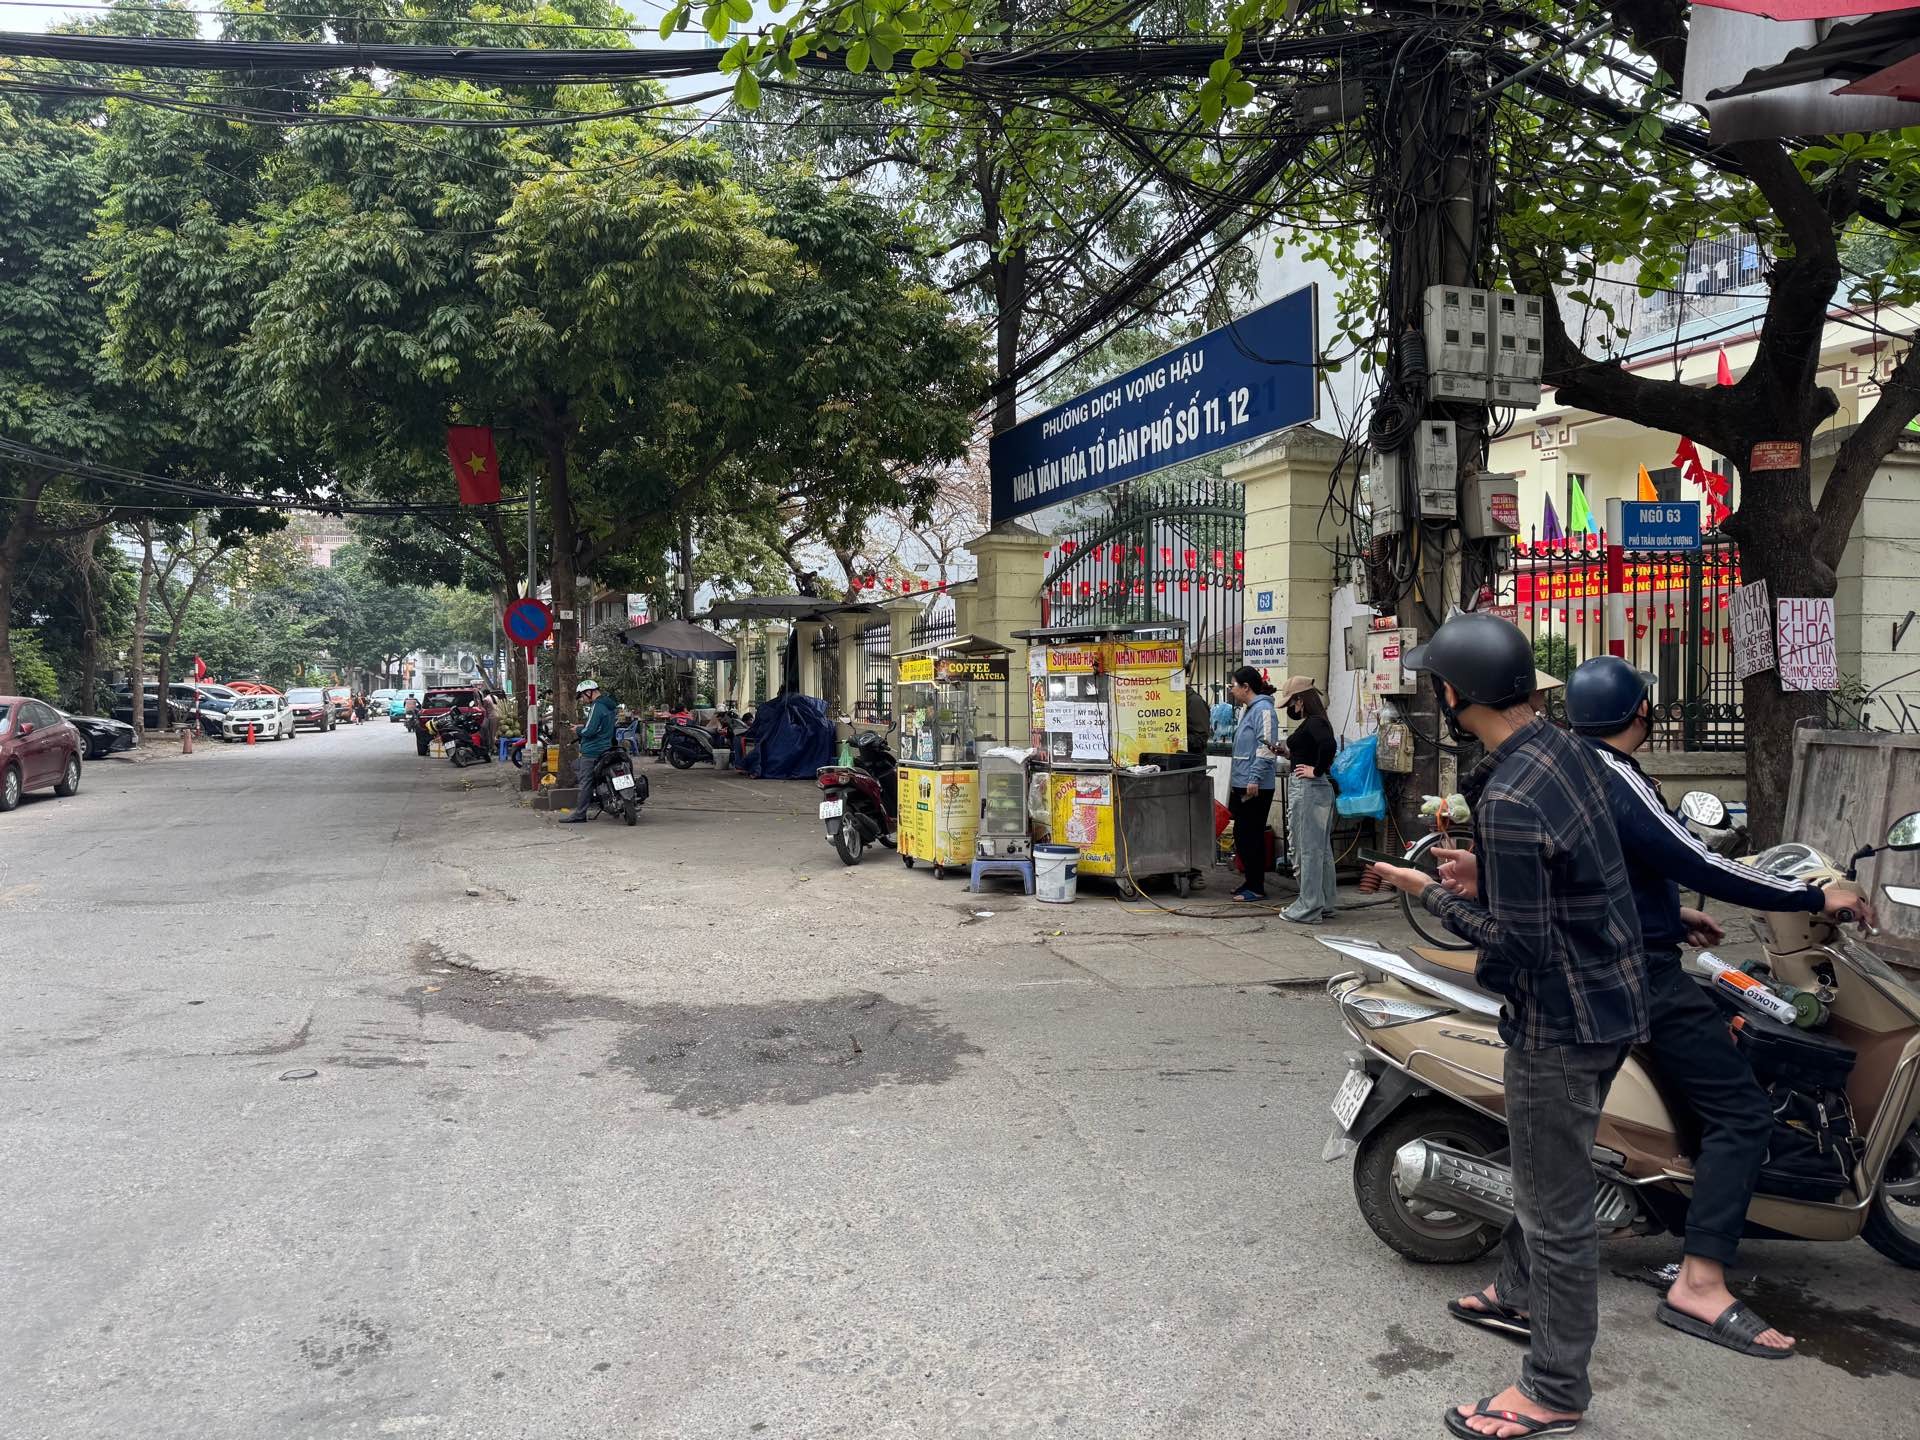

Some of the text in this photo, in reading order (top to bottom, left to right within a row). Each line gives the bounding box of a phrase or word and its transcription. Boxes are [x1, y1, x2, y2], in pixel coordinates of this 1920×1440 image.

[1043, 350, 1204, 439] PHƯỜNG DỊCH VỌNG HẬU
[1013, 466, 1035, 503] NHÀ
[1037, 458, 1060, 494] VĂN
[1062, 446, 1087, 483] HÓA
[1089, 428, 1104, 475] TỔ
[1108, 427, 1139, 470] DÂN
[1141, 402, 1173, 457] PHỐ
[1176, 390, 1200, 445] SỐ
[1203, 397, 1225, 435] 11,
[1228, 387, 1250, 426] 12
[1640, 505, 1680, 523] NGÕ 63
[1629, 532, 1639, 545] PHỐ
[1641, 532, 1655, 545] TRẦN
[1656, 533, 1671, 546] QUỐC
[1260, 594, 1270, 608] 63
[1254, 624, 1276, 635] CẤM
[949, 663, 990, 672] COFFEE
[1116, 677, 1152, 686] COMBO
[1145, 691, 1160, 700] 30k
[1137, 709, 1173, 718] COMBO
[1165, 723, 1180, 732] 25k
[1747, 990, 1780, 1011] ALOKEO
